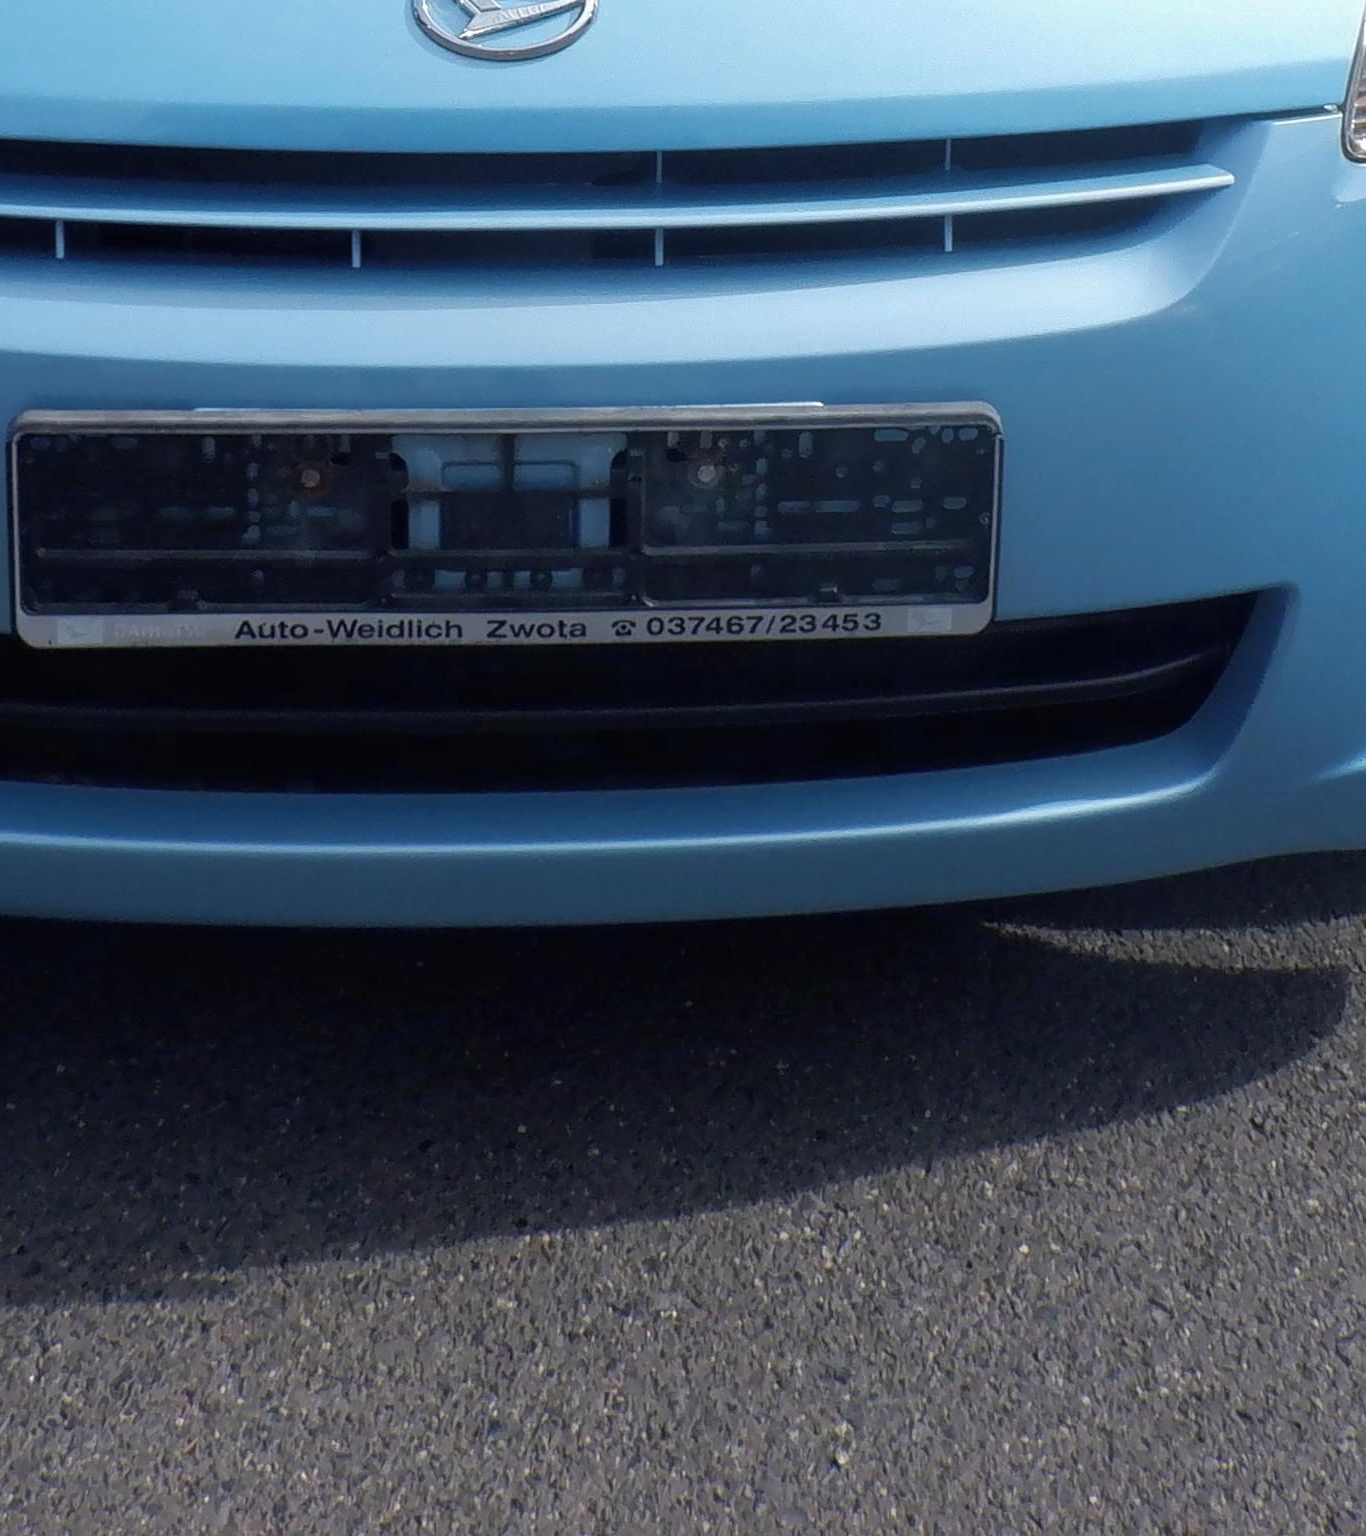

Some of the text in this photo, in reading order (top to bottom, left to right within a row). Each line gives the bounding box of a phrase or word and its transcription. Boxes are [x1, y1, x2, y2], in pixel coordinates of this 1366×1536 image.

[235, 612, 882, 641] Auto-Weidlich Zwota 037467/23453
